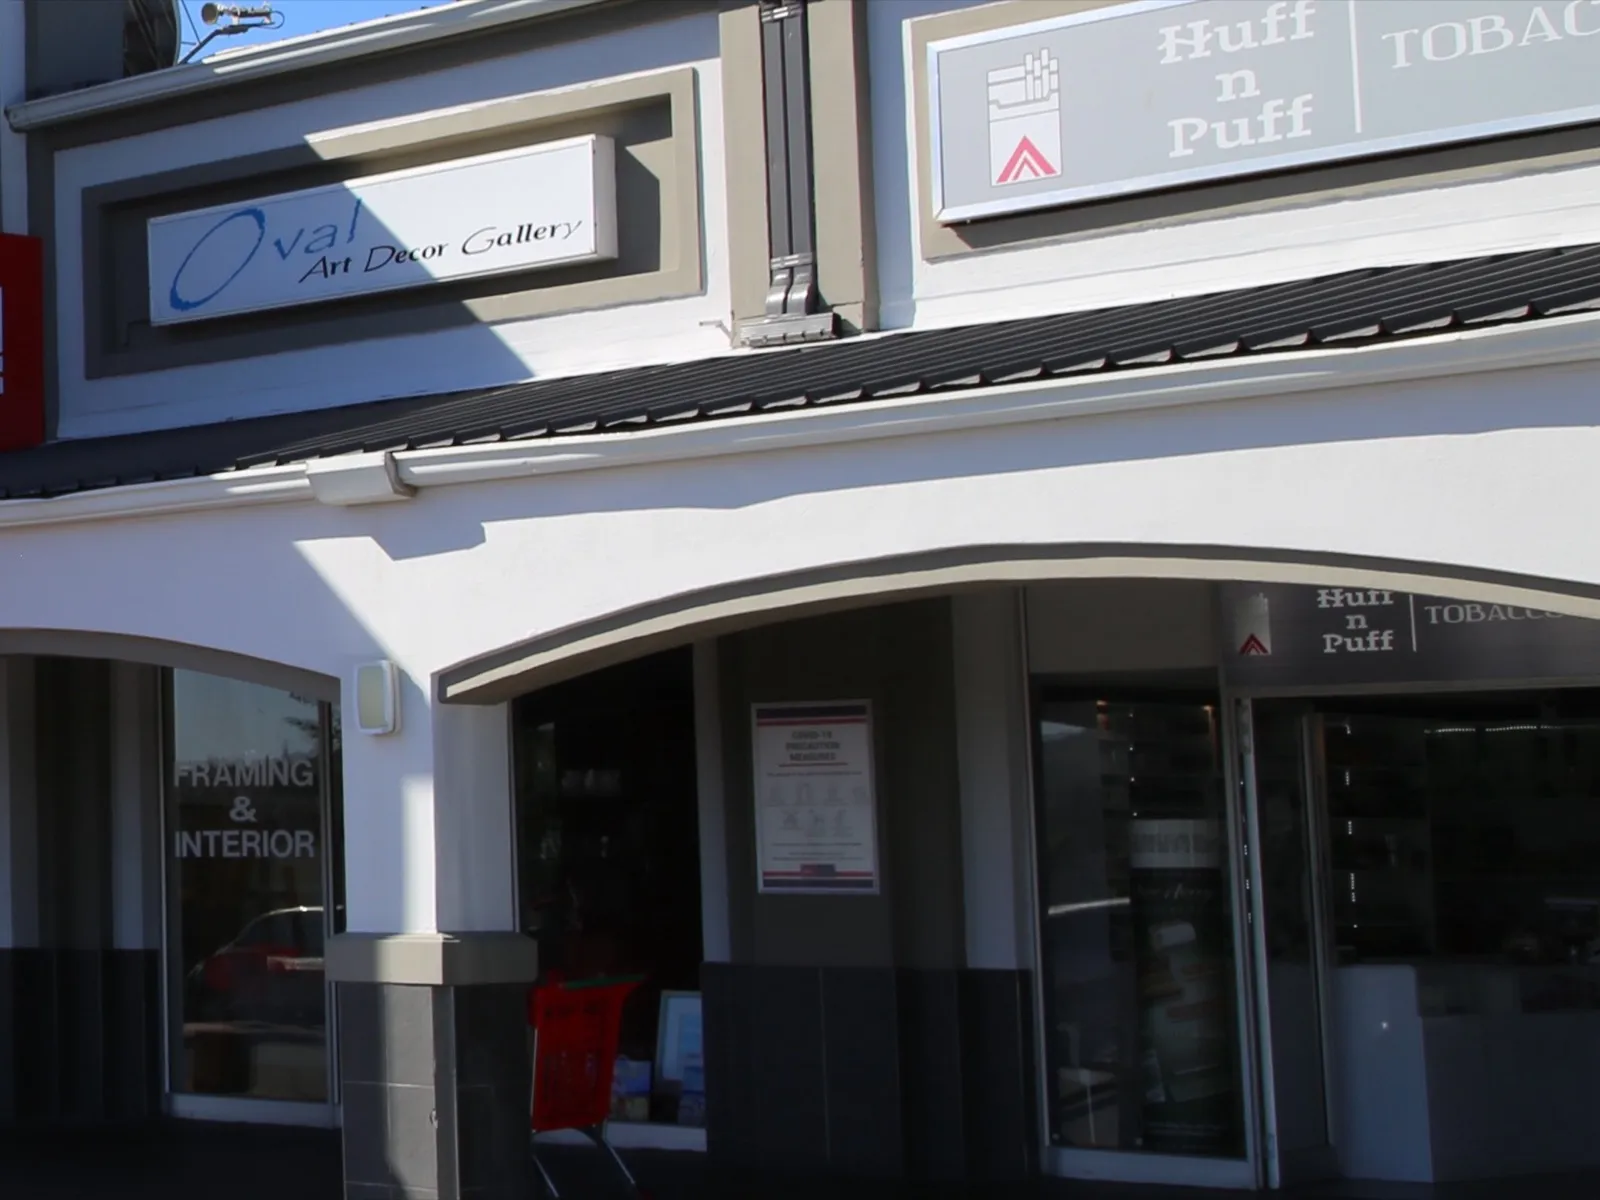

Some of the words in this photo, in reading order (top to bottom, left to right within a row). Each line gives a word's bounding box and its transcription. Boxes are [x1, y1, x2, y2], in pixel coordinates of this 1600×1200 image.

[1157, 0, 1316, 64] Huff
[1215, 69, 1260, 102] n
[1167, 93, 1313, 158] Puff
[170, 198, 362, 311] Oval
[298, 255, 352, 284] Art
[364, 242, 448, 273] Decor
[461, 220, 582, 256] Gallery
[1317, 588, 1394, 608] Huff
[1345, 615, 1368, 629] n
[1322, 630, 1394, 653] Puff
[174, 760, 313, 787] FRAMING
[229, 796, 257, 822] &
[175, 829, 315, 858] INTERIOR
